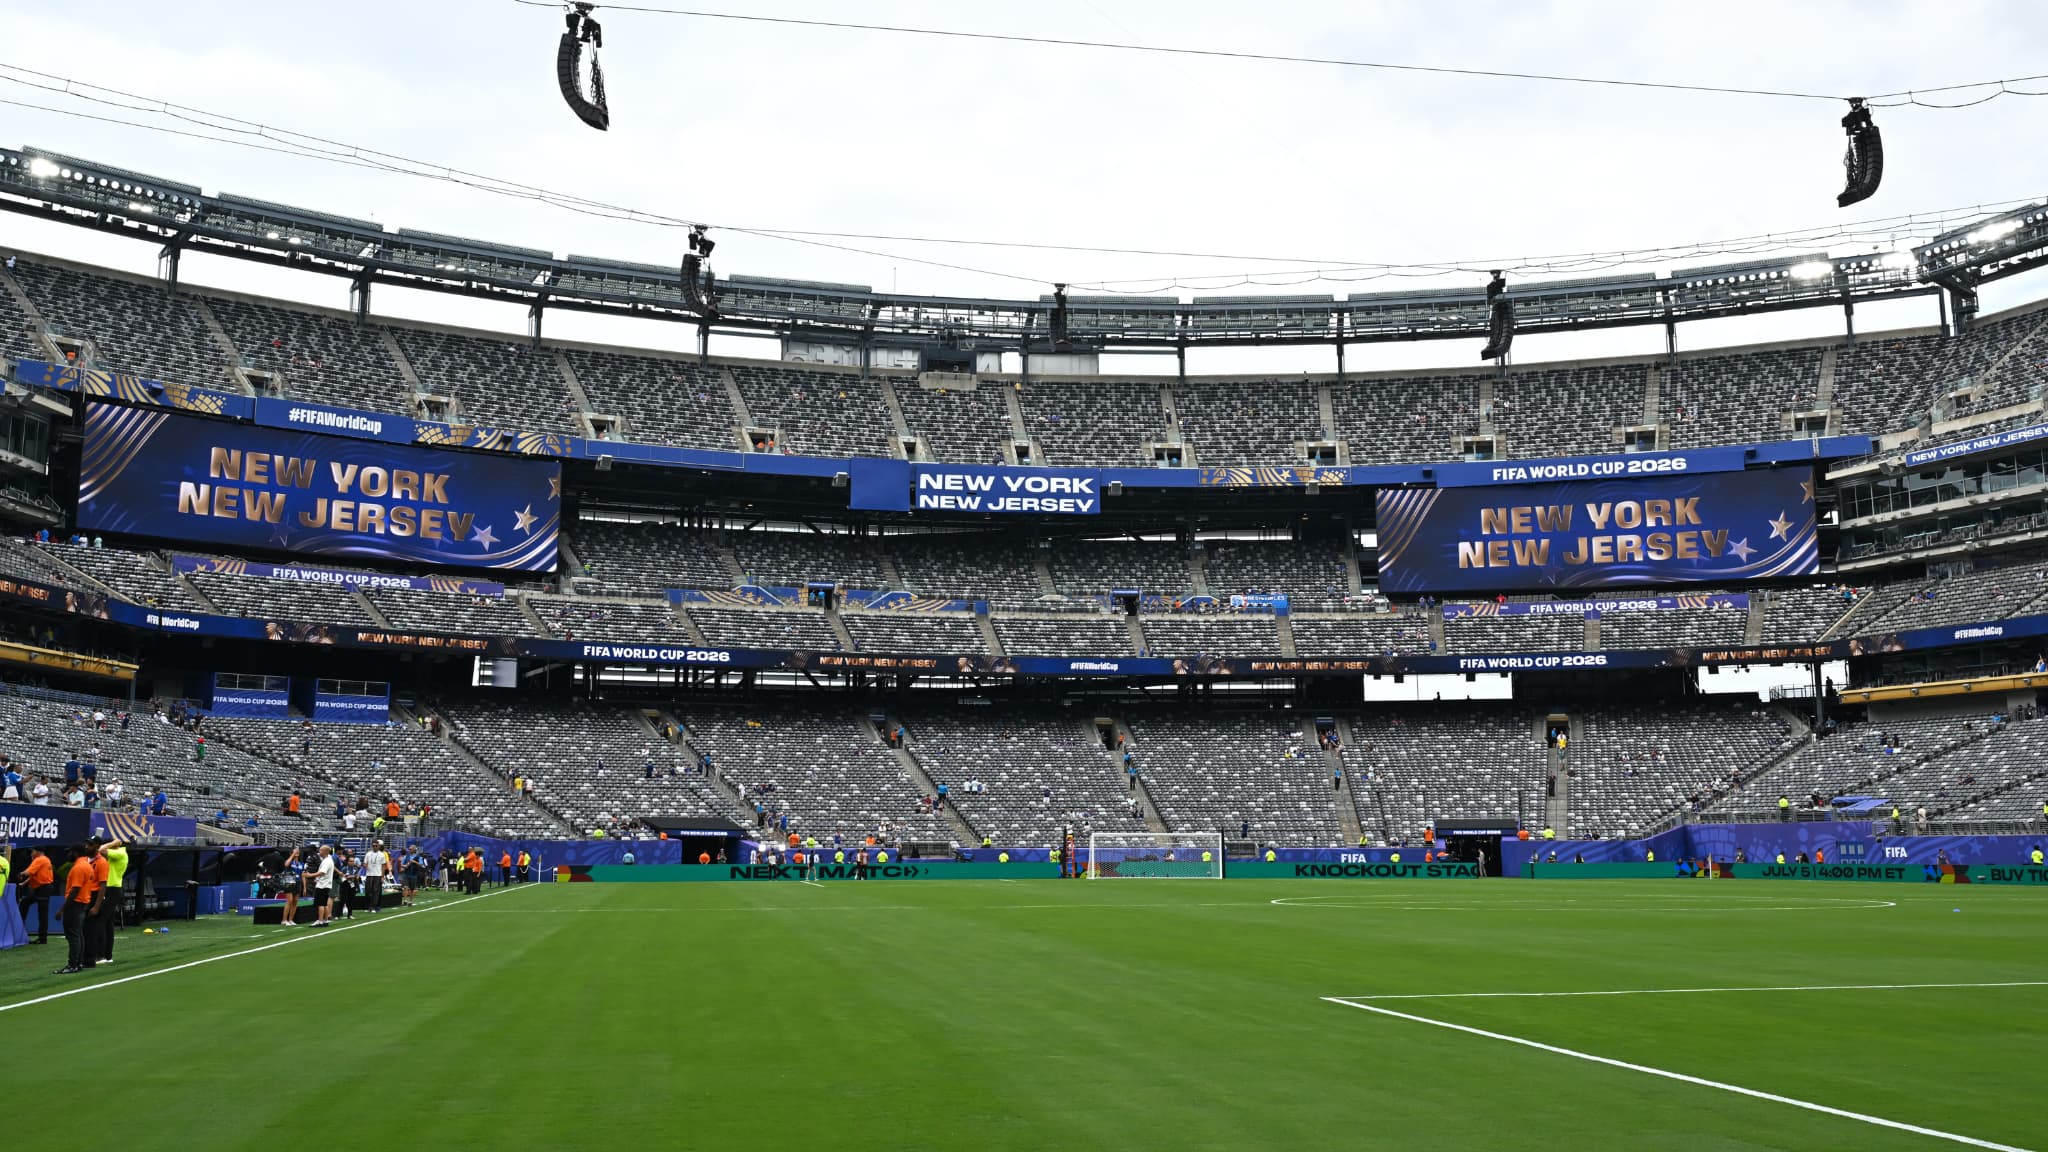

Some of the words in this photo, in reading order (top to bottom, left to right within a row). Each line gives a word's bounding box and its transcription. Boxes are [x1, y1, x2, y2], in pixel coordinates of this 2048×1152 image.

[288, 407, 382, 435] #FIFAWorldCup
[1912, 450, 1938, 462] NEW
[1939, 443, 1971, 456] YORK
[1973, 437, 2000, 448] NEW
[210, 446, 316, 488] NEW
[330, 462, 449, 504] YORK
[1492, 467, 1527, 481] FIFA
[1530, 463, 1589, 479] WORLD
[1591, 461, 1624, 475] CUP
[1627, 458, 1687, 473] 2026
[919, 473, 995, 491] NEW
[1003, 476, 1094, 494] YORK
[919, 495, 982, 510] NEW
[988, 498, 1094, 513] JERSEY
[178, 481, 287, 523] NEW
[299, 498, 475, 542] JERSEY
[1480, 504, 1572, 535] NEW
[1586, 496, 1702, 530] YORK
[1458, 538, 1550, 569] NEW
[1562, 528, 1729, 565] JERSEY
[272, 567, 299, 579] FIFA
[300, 570, 344, 583] WORLD
[346, 574, 368, 585] CUP
[367, 576, 411, 588] 2026
[1530, 604, 1552, 614] FIFA
[1554, 603, 1594, 613] WORLD
[1595, 602, 1618, 611] CUP
[1619, 600, 1658, 610] 2026
[358, 632, 384, 643] NEW
[386, 634, 417, 645] YORK
[419, 636, 444, 648] NEW
[1955, 626, 2003, 640] #FIFAWorldCup
[583, 645, 610, 657] FIFA
[612, 647, 658, 660] WORLD
[660, 649, 685, 661] CUP
[686, 651, 730, 662] 2026
[1702, 651, 1728, 661] NEW
[1762, 648, 1788, 659] NEW
[819, 656, 843, 666] NEW
[874, 658, 897, 667] NEW
[1070, 662, 1119, 672] #FIFAWorldCup
[1251, 662, 1275, 671] NEW
[1306, 661, 1329, 670] NEW
[1460, 658, 1486, 669] FIFA
[1487, 657, 1534, 668] WORLD
[1535, 656, 1561, 667] CUP
[1562, 655, 1608, 666] 2026
[228, 697, 251, 705] WORLD
[9, 816, 28, 838] CUP
[28, 817, 59, 839] 2026
[1341, 853, 1367, 863] FIFA
[1885, 847, 1908, 858] FIFA
[730, 866, 808, 879] NEXT
[1296, 864, 1422, 877] KNOCKOUT
[1427, 864, 1478, 877] STA
[1762, 867, 1797, 878] JULY
[1819, 867, 1854, 879] 4:00
[1857, 867, 1883, 879] PM
[1885, 868, 1905, 879] ET
[1991, 868, 2024, 881] BUY
